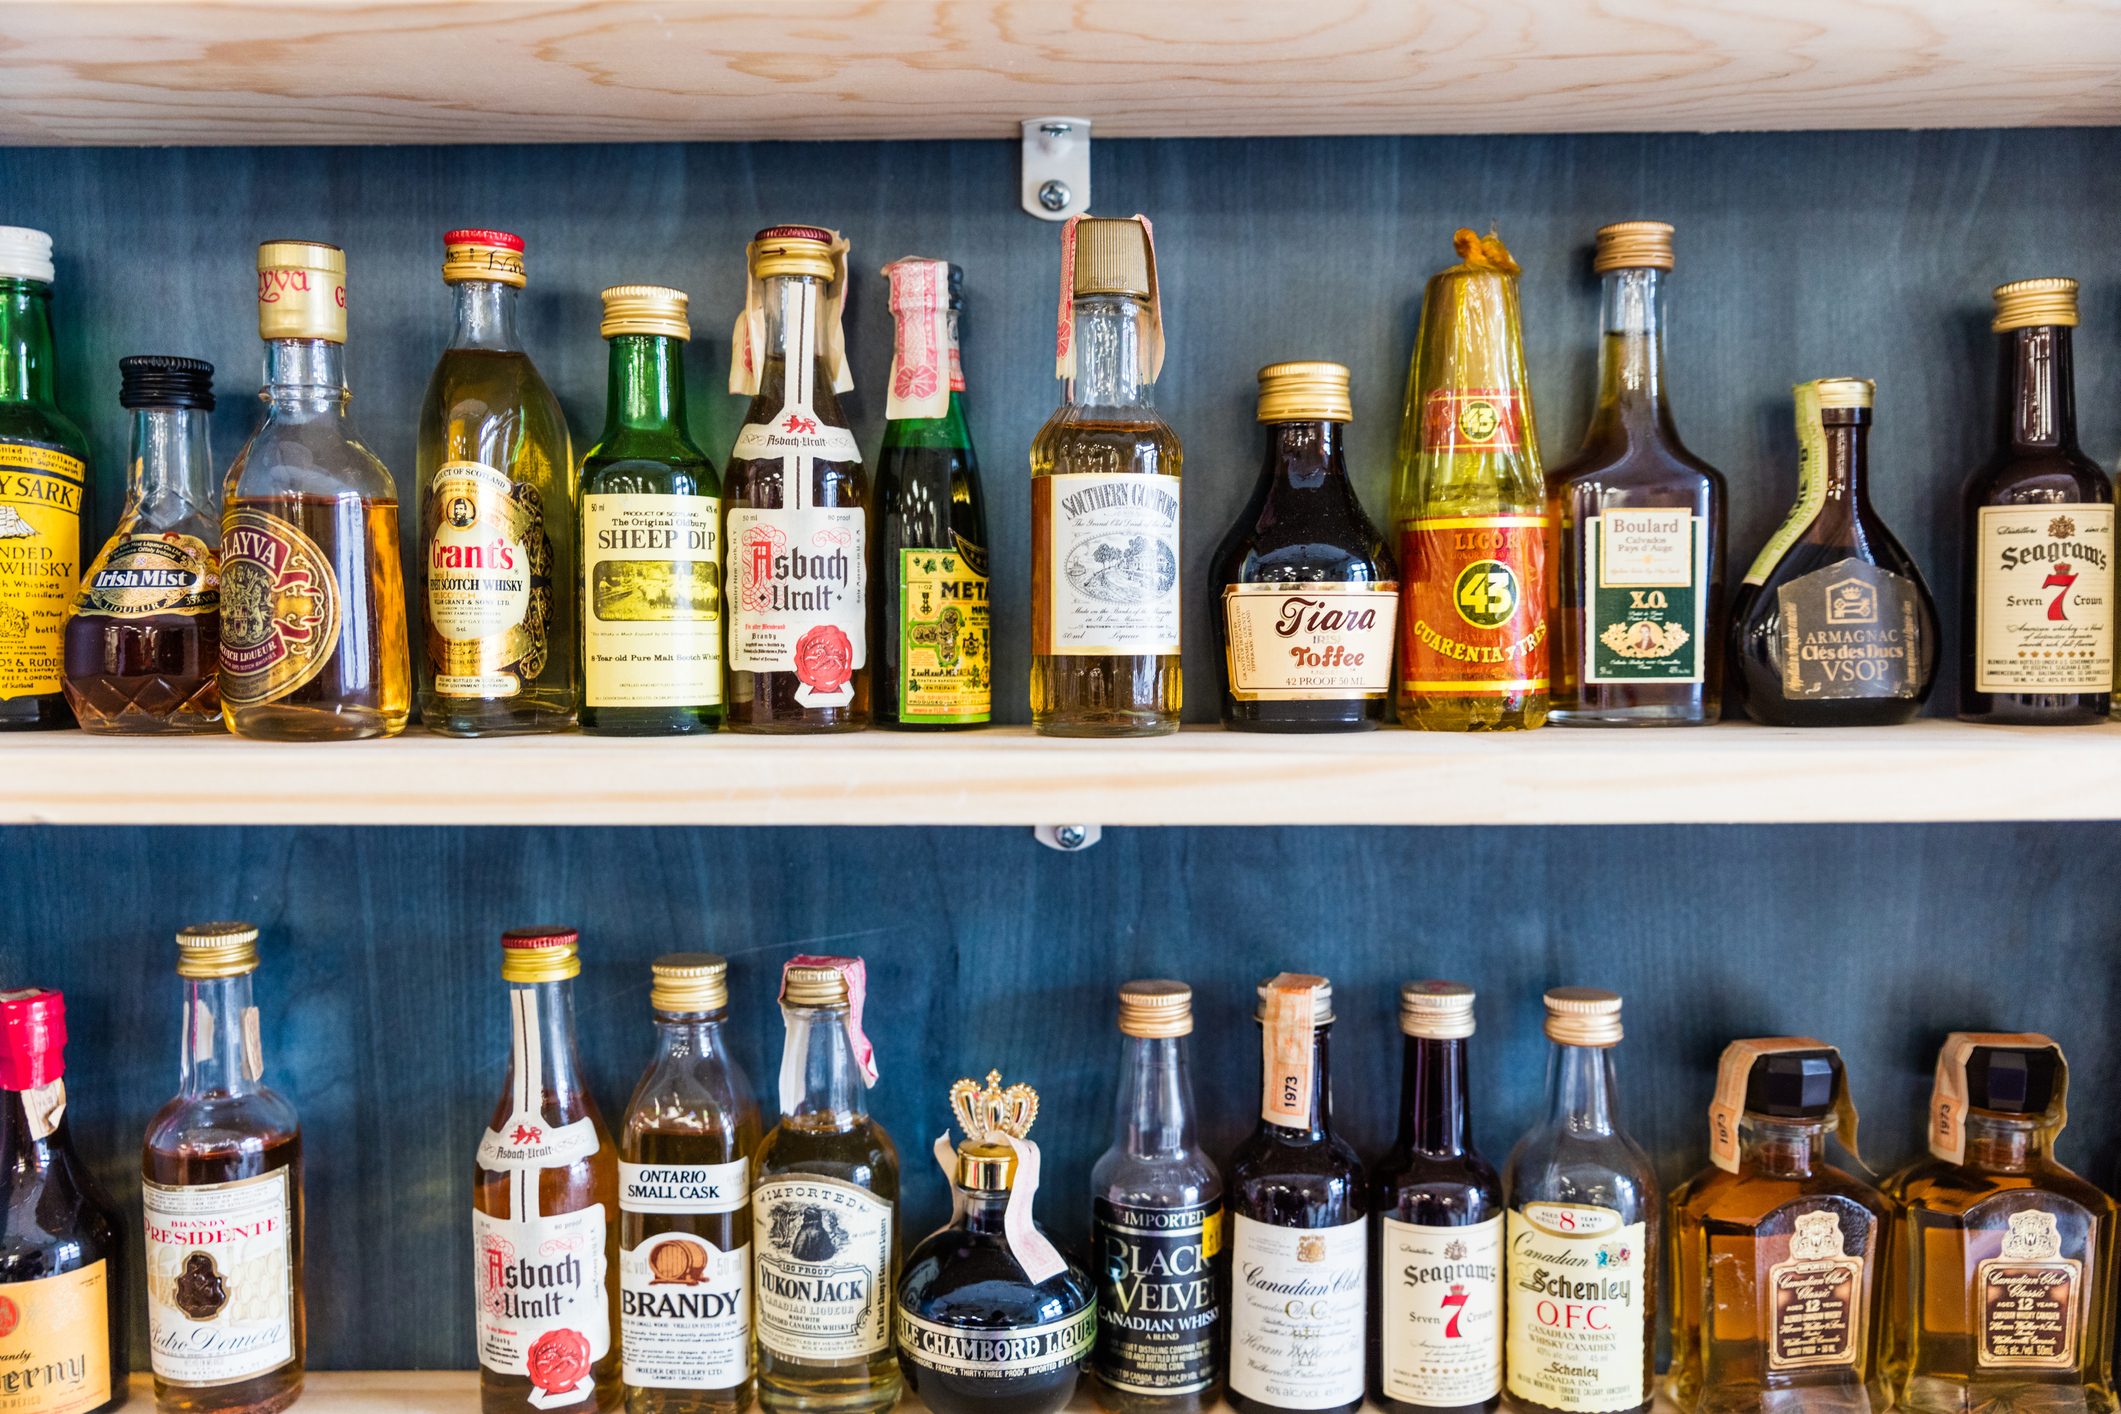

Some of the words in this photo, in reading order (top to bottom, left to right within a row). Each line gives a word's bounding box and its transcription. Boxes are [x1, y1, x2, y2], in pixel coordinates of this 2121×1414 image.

[1462, 407, 1495, 433] 43
[15, 476, 74, 508] SARK
[1061, 483, 1129, 521] SOUTHERN
[612, 518, 629, 526] The
[631, 518, 674, 528] Original
[1613, 518, 1679, 533] Boulard
[598, 529, 679, 550] SHEEP
[687, 530, 716, 550] DIP
[433, 538, 514, 570] Grant's
[2001, 541, 2107, 571] Seagram's
[0, 562, 73, 577] WHISKY
[750, 540, 849, 589] Asbach
[14, 581, 60, 590] Whiskies
[95, 570, 139, 588] Irish
[140, 570, 188, 587] Mist
[441, 579, 480, 591] SCOTCH
[482, 579, 524, 592] WHISKY
[771, 583, 833, 612] Uralt
[1460, 572, 1512, 614] 43
[2006, 596, 2043, 607] Seven
[2073, 595, 2103, 606] Crown
[2042, 573, 2079, 621] 7
[103, 601, 161, 614] LIQUEUR
[1275, 597, 1377, 637] Tiara
[1413, 619, 1505, 664] CUARENTA
[1514, 619, 1547, 657] TRES
[1805, 629, 1900, 644] ARMAGNAC
[240, 641, 278, 662] LIQUEUR
[1290, 645, 1365, 668] Toffee
[1801, 644, 1836, 660] Clés
[1837, 644, 1865, 660] des
[1866, 643, 1904, 659] Ducs
[1820, 659, 1889, 682] VSOP
[1285, 677, 1297, 686] 42
[1299, 677, 1337, 686] PROOF
[1338, 677, 1349, 686] 50
[1284, 1076, 1299, 1107] 1973
[1940, 1103, 1951, 1135] 1973
[639, 1169, 707, 1184] ONTARIO
[628, 1185, 677, 1198] SMALL
[679, 1185, 720, 1199] CASK
[765, 1187, 857, 1208] IMPORTED
[171, 1218, 227, 1228] BRANDY
[1124, 1209, 1206, 1229] IMPORTED
[1559, 1211, 1576, 1231] 8
[1513, 1230, 1590, 1267] Canadian
[485, 1247, 582, 1296] Asbach
[782, 1264, 796, 1272] 100
[798, 1265, 830, 1275] PROOF
[1242, 1260, 1329, 1296] Canadian
[1403, 1263, 1496, 1288] Seagram's
[1778, 1275, 1825, 1289] Canadian
[1823, 1270, 1851, 1285] Club
[1988, 1271, 2039, 1285] Canadian
[2038, 1271, 2068, 1285] Club
[760, 1263, 812, 1300] YUKON
[813, 1279, 864, 1303] JACK
[1519, 1267, 1631, 1307] Schenley
[2007, 1284, 2046, 1298] Classic
[503, 1293, 564, 1319] Uralt
[621, 1288, 742, 1319] BRANDY
[764, 1295, 807, 1315] CANADIAN
[1805, 1299, 1821, 1313] 12
[2017, 1298, 2035, 1311] 12
[790, 1319, 821, 1331] CANADIAN
[822, 1323, 850, 1331] WHISKY
[804, 1315, 820, 1323] WITH
[1100, 1305, 1175, 1332] CANADIAN
[1409, 1311, 1441, 1324] Seven
[1440, 1292, 1471, 1339] 7
[1536, 1300, 1612, 1331] O.F.C.
[1152, 1333, 1180, 1341] BLEND
[1528, 1323, 1576, 1340] CANADIAN
[1579, 1332, 1617, 1341] WHISKY
[1529, 1333, 1563, 1349] WHISKY
[923, 1331, 1041, 1362] CHAMBORD
[1028, 1362, 1057, 1375] IMPORTED
[1544, 1361, 1599, 1382] Schenley
[1536, 1372, 1576, 1386] CANADA
[1264, 1385, 1282, 1396] 40%
